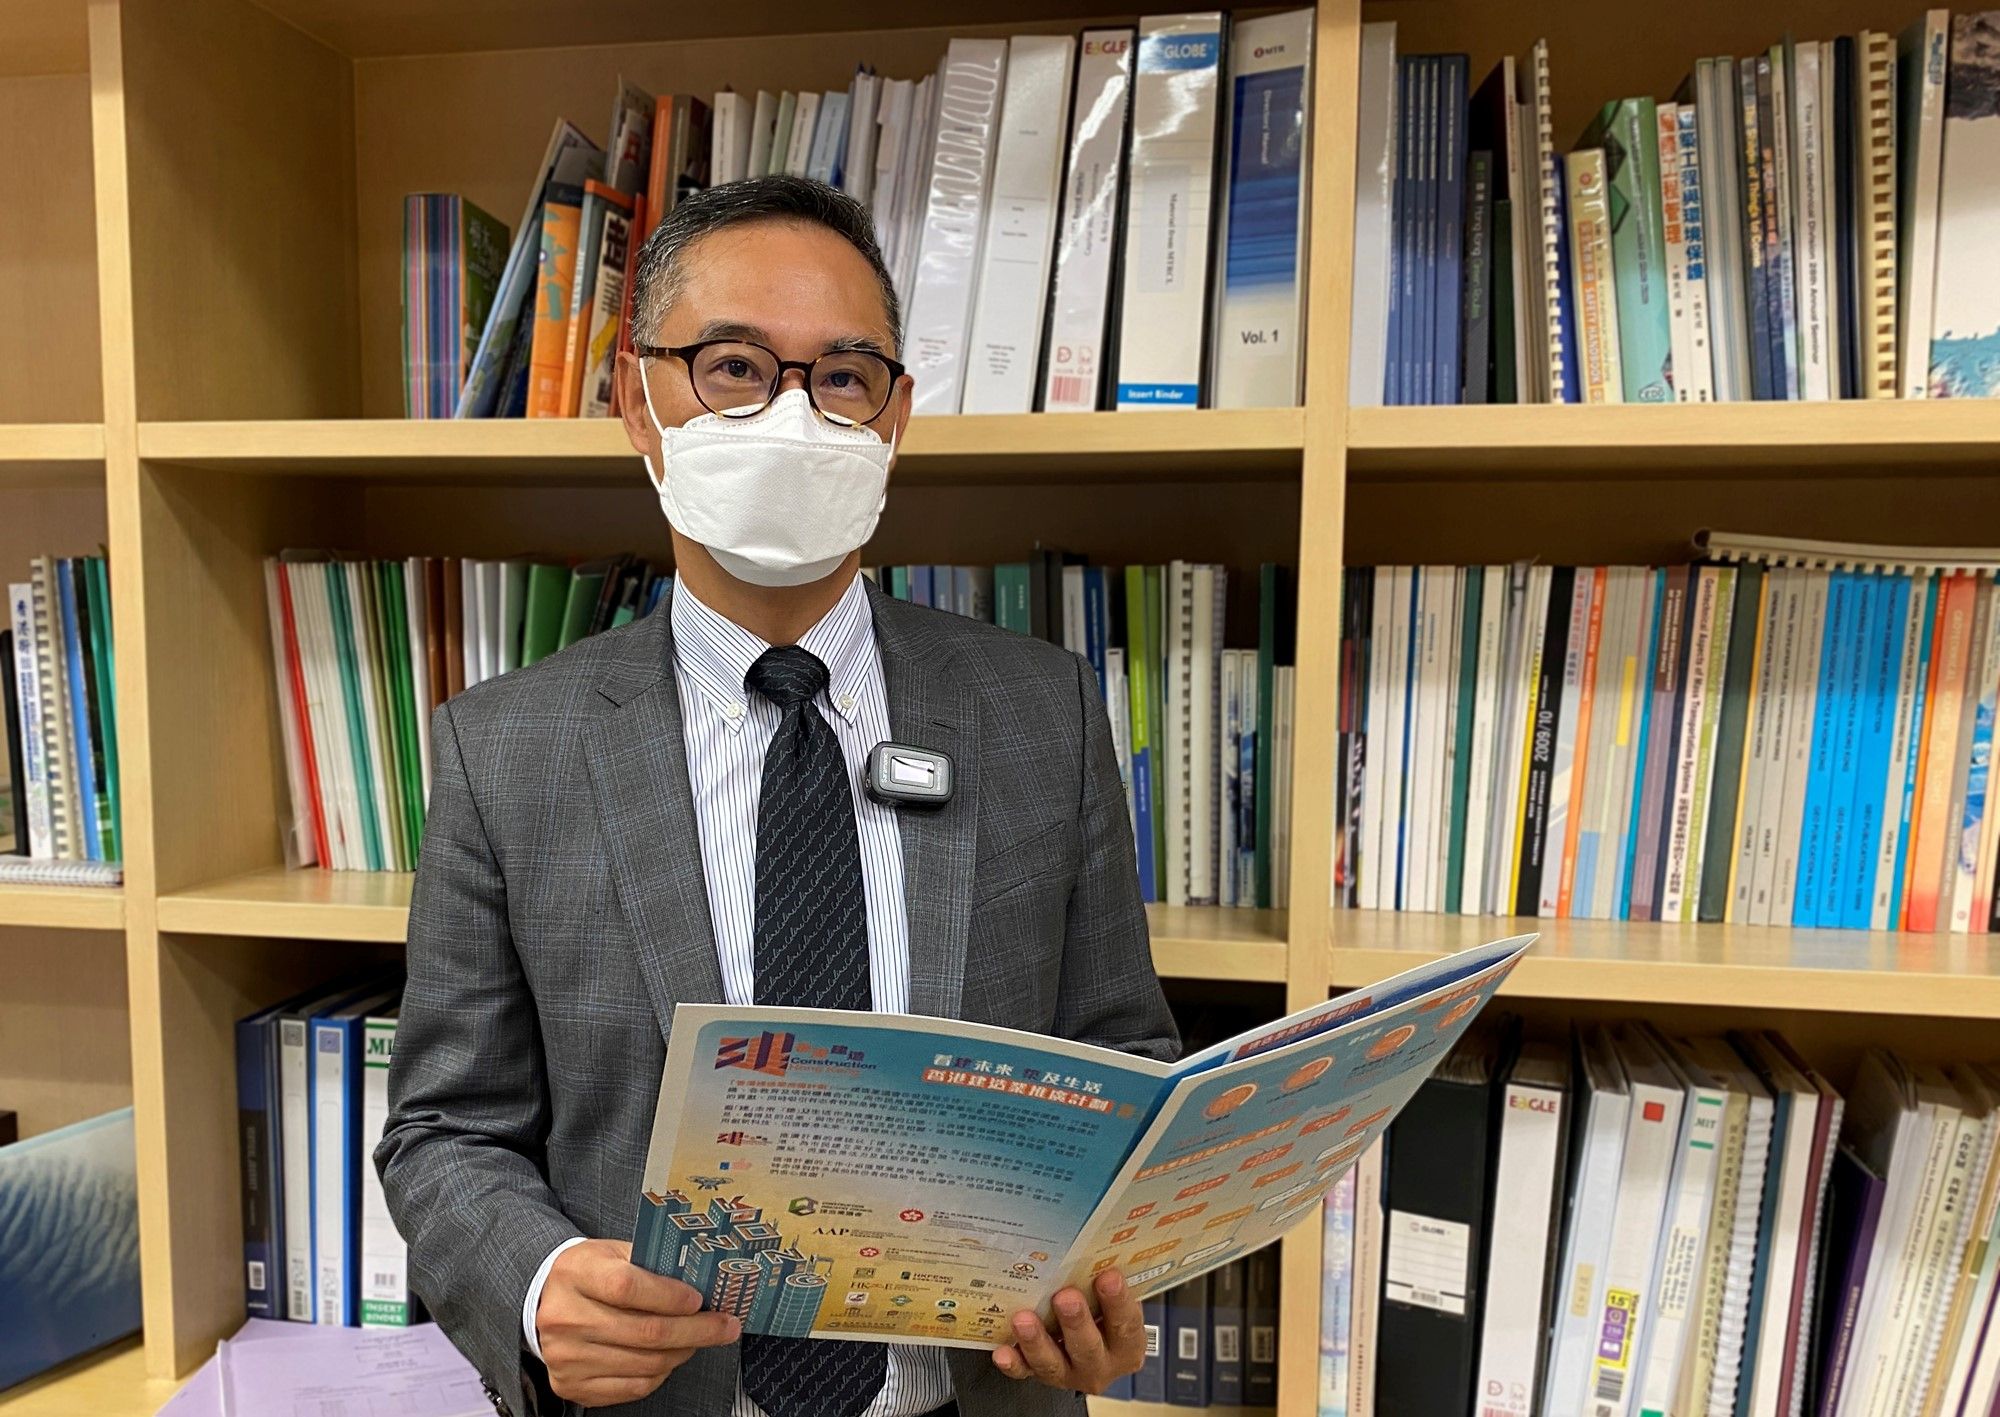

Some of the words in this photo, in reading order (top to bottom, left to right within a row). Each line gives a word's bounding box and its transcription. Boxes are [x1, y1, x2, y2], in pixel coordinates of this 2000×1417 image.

[1163, 43, 1207, 59] GLOBE
[1265, 45, 1285, 55] MTR
[1747, 183, 1760, 218] Things
[1806, 153, 1816, 219] Geotechnical
[1169, 193, 1178, 227] Material
[1750, 221, 1760, 234] to
[1808, 221, 1817, 260] Division
[1750, 236, 1762, 268] Come
[1584, 287, 1596, 325] SAFETY
[1810, 288, 1819, 321] Annual
[1241, 329, 1266, 344] Vol.
[1272, 329, 1279, 344] 1
[1811, 324, 1819, 364] Seminar
[1587, 326, 1600, 384] HANDBOOK
[1128, 389, 1153, 399] Insert
[1155, 390, 1184, 400] Binder
[1672, 589, 1682, 625] PLANNING
[1701, 578, 1714, 631] Geotechnical
[1771, 591, 1780, 617] GENERAL
[1788, 594, 1797, 620] GENERAL
[1833, 584, 1845, 632] ENGINEERING
[1857, 584, 1870, 632] ENGINEERING
[1886, 583, 1898, 630] FOUNDATION
[1912, 592, 1921, 620] GENERAL
[1662, 600, 1673, 651] UNDERGROUND
[1765, 620, 1776, 663] SPECIFICATION
[1695, 633, 1707, 665] Aspects
[1783, 623, 1794, 667] SPECIFICATION
[1827, 635, 1839, 680] GEOLOGICAL
[1852, 635, 1865, 681] GEOLOGICAL
[1883, 632, 1892, 659] DESIGN
[1906, 622, 1918, 666] SPECIFICATION
[1946, 610, 1963, 681] GEOTECHNICAL
[1659, 653, 1667, 673] SPACE
[1665, 643, 1677, 690] DEVELOPMENT
[1694, 668, 1704, 676] of
[1692, 678, 1702, 698] Mass
[1824, 682, 1833, 717] PRACTICE
[1848, 683, 1859, 718] PRACTICE
[1874, 677, 1887, 733] CONSTRUCTION
[1757, 695, 1767, 735] ENGINEERING
[1776, 698, 1786, 738] ENGINEERING
[1898, 698, 1909, 738] ENGINEERING
[1939, 691, 1954, 731] MANUAL
[1534, 711, 1553, 762] 2009/10
[1685, 700, 1700, 759] Transportation
[1819, 729, 1829, 749] HONG
[1844, 729, 1854, 750] HONG
[1755, 736, 1763, 758] WORKS
[1773, 739, 1781, 761] WORKS
[1817, 751, 1826, 772] KONG
[1842, 752, 1851, 772] KONG
[1895, 740, 1904, 762] WORKS
[1681, 760, 1694, 794] Systems
[1697, 748, 1708, 789] DRAINAGE
[1537, 770, 1546, 804] AUTHORITY
[1535, 806, 1543, 834] DISTRICT
[1812, 805, 1821, 823] GEO
[1837, 807, 1845, 823] GEO
[1863, 804, 1872, 821] GEO
[1763, 829, 1771, 852] VOLUME
[1808, 825, 1818, 874] PUBLICATION
[1832, 825, 1843, 875] PUBLICATION
[1859, 823, 1870, 873] PUBLICATION
[1885, 831, 1894, 855] VOLUME
[790, 1057, 877, 1069] Construction
[927, 1070, 1110, 1112] 香港建造業推廣計劃
[1696, 1117, 1716, 1128] MIT
[1930, 1142, 1944, 1168] Changes
[1333, 1180, 1347, 1230] Edward
[813, 1227, 850, 1236] AAP
[1421, 1225, 1445, 1235] GLOBE
[1331, 1260, 1346, 1279] Ho
[1897, 1263, 1913, 1301] Construction
[366, 1302, 402, 1312] INSERT
[366, 1312, 402, 1323] BINDER
